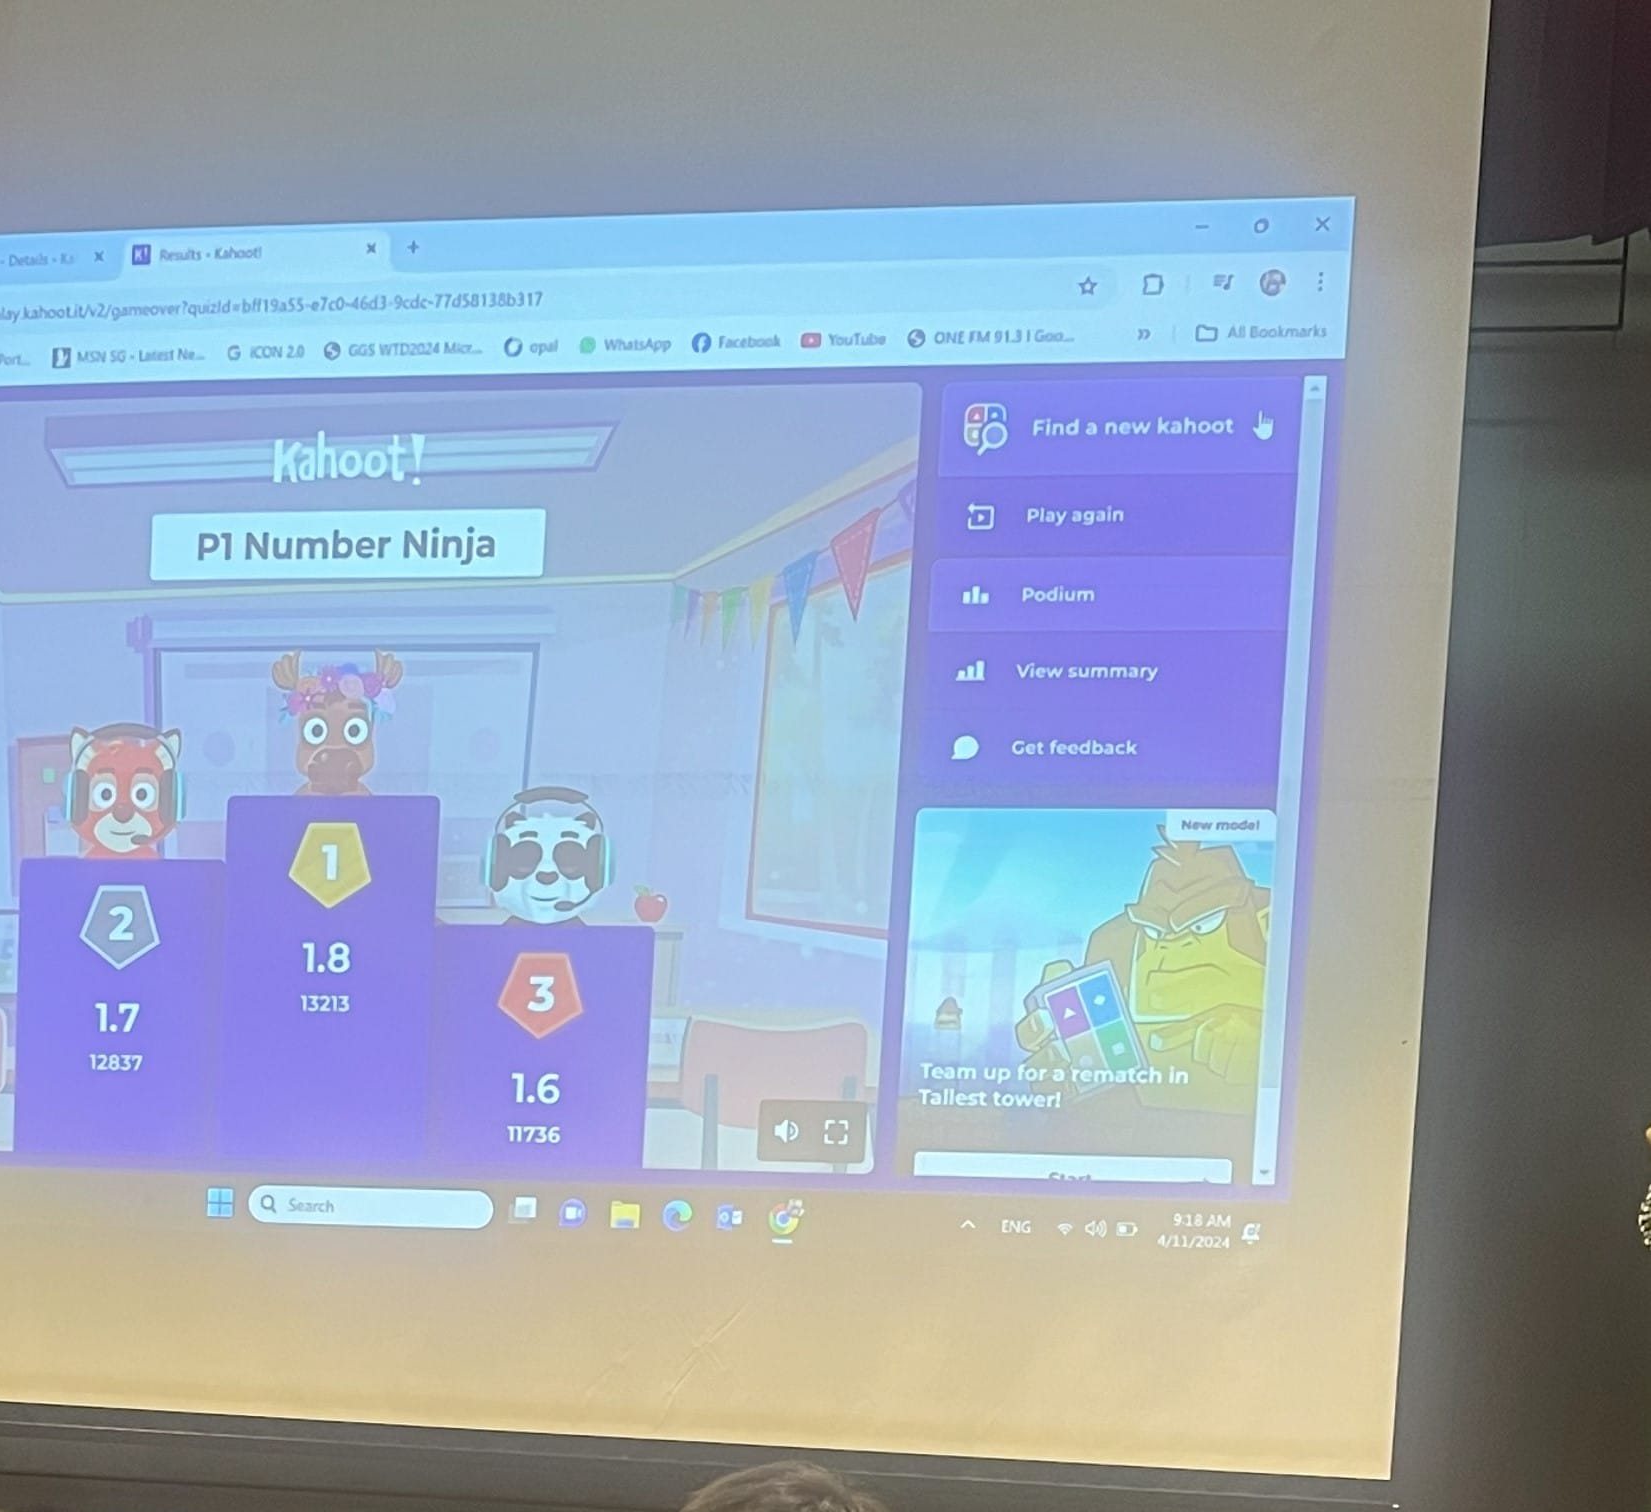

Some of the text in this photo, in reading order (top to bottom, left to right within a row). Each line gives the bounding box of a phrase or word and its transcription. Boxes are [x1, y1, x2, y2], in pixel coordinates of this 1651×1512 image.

[9, 253, 47, 267] Details
[159, 249, 201, 262] Results
[934, 331, 964, 345] ONE
[968, 330, 990, 344] FM
[994, 329, 1022, 343] 91.3
[1228, 323, 1328, 339] All Bookmarks
[529, 339, 559, 355] opal
[604, 338, 671, 352] WhatsApp
[718, 334, 781, 349] Facebook
[828, 333, 886, 347] YouTube
[77, 351, 105, 363] MSN
[110, 350, 125, 362] SG
[139, 348, 174, 361] Latest
[286, 344, 305, 358] 2.0
[348, 343, 375, 357] GGS
[379, 341, 440, 356] WTD2024
[1032, 417, 1234, 437] Find a new kahoot
[272, 431, 426, 485] Kahoot!
[1027, 505, 1124, 526] Play again
[197, 527, 495, 566] P1 Number Ninja
[1022, 587, 1095, 603] Podium
[1017, 663, 1159, 681] View summary
[1011, 740, 1138, 755] Get feedback
[1181, 820, 1212, 830] New
[320, 844, 337, 881] 1
[109, 906, 134, 940] 2
[302, 942, 351, 974] 1.8
[528, 976, 555, 1012] 3
[300, 994, 350, 1012] 13213
[95, 1002, 140, 1033] 1.7
[89, 1054, 143, 1071] 12837
[921, 1063, 1189, 1086] Team up for a rematch in
[511, 1073, 561, 1104] 1.6
[919, 1088, 1061, 1108] Tallest tower!
[507, 1126, 561, 1144] 11736
[288, 1198, 335, 1214] Search
[1001, 1220, 1031, 1234] ENG
[1206, 1214, 1232, 1228] AM
[1157, 1234, 1230, 1249] 4/11/2024
